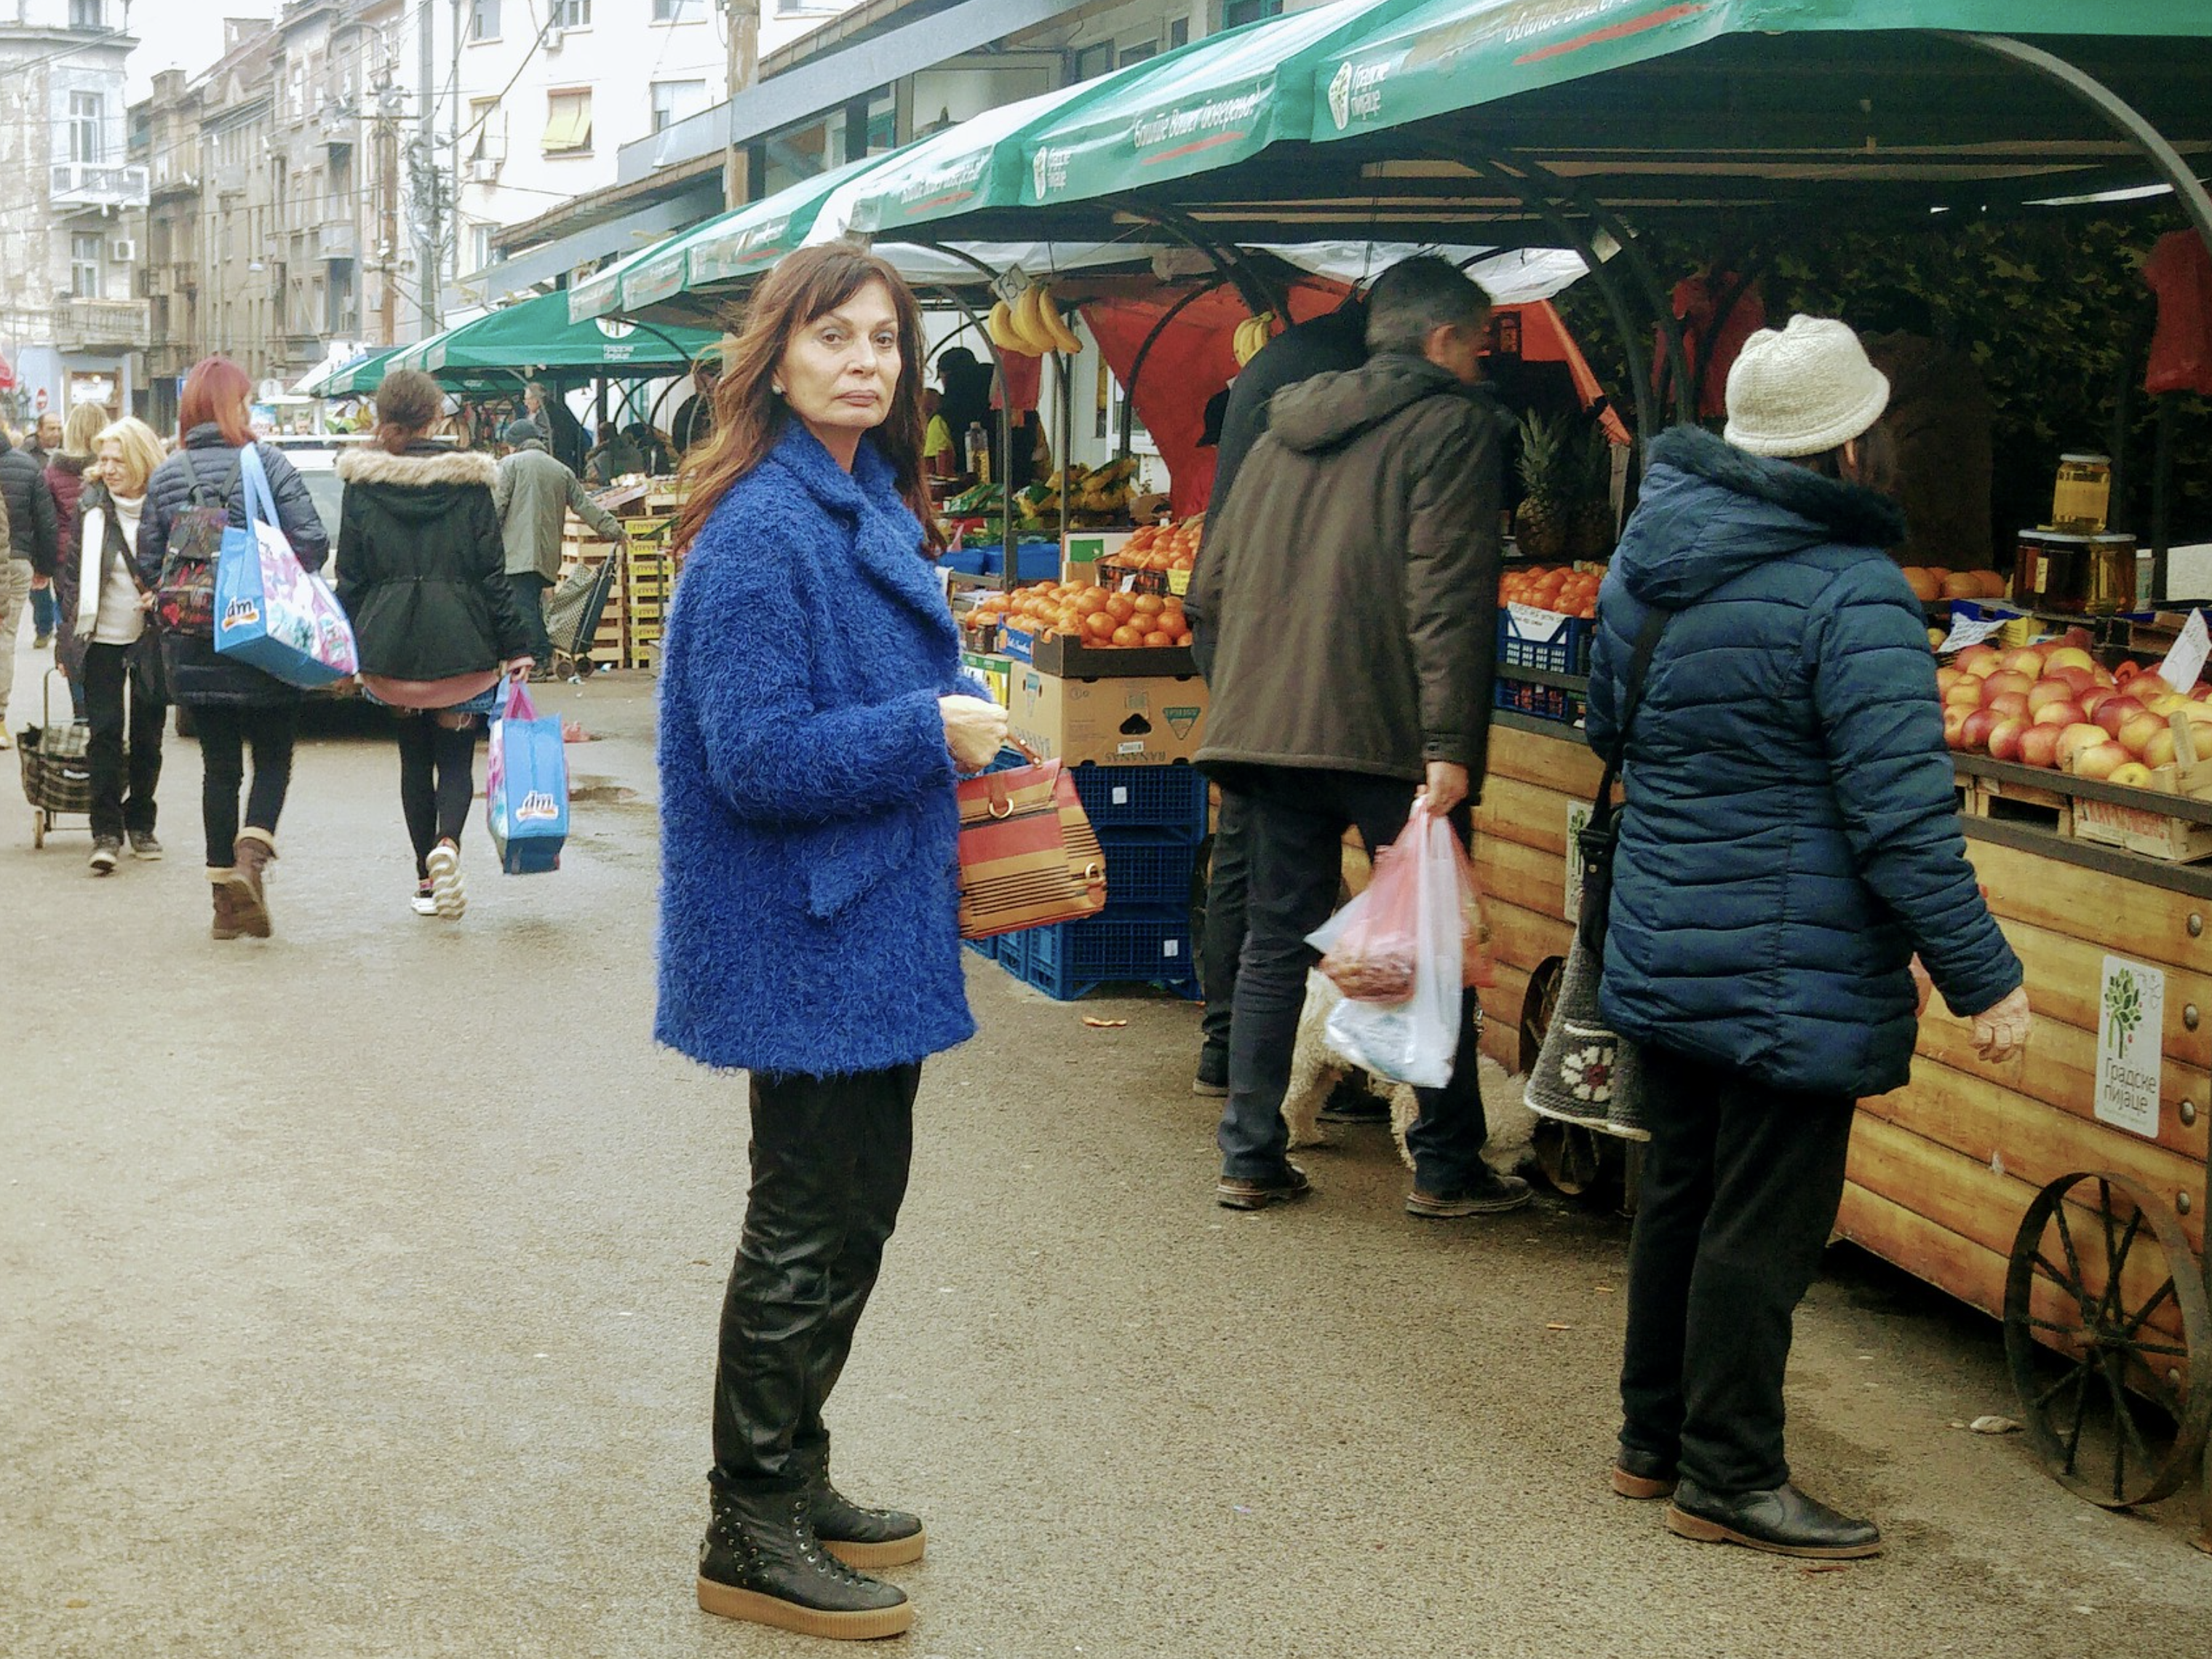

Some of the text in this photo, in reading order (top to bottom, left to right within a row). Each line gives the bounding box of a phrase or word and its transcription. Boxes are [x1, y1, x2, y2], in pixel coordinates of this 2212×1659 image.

[227, 600, 252, 618] dm
[524, 792, 552, 811] dm
[2105, 1057, 2157, 1094] Градске
[2104, 1084, 2149, 1117] пијаце
